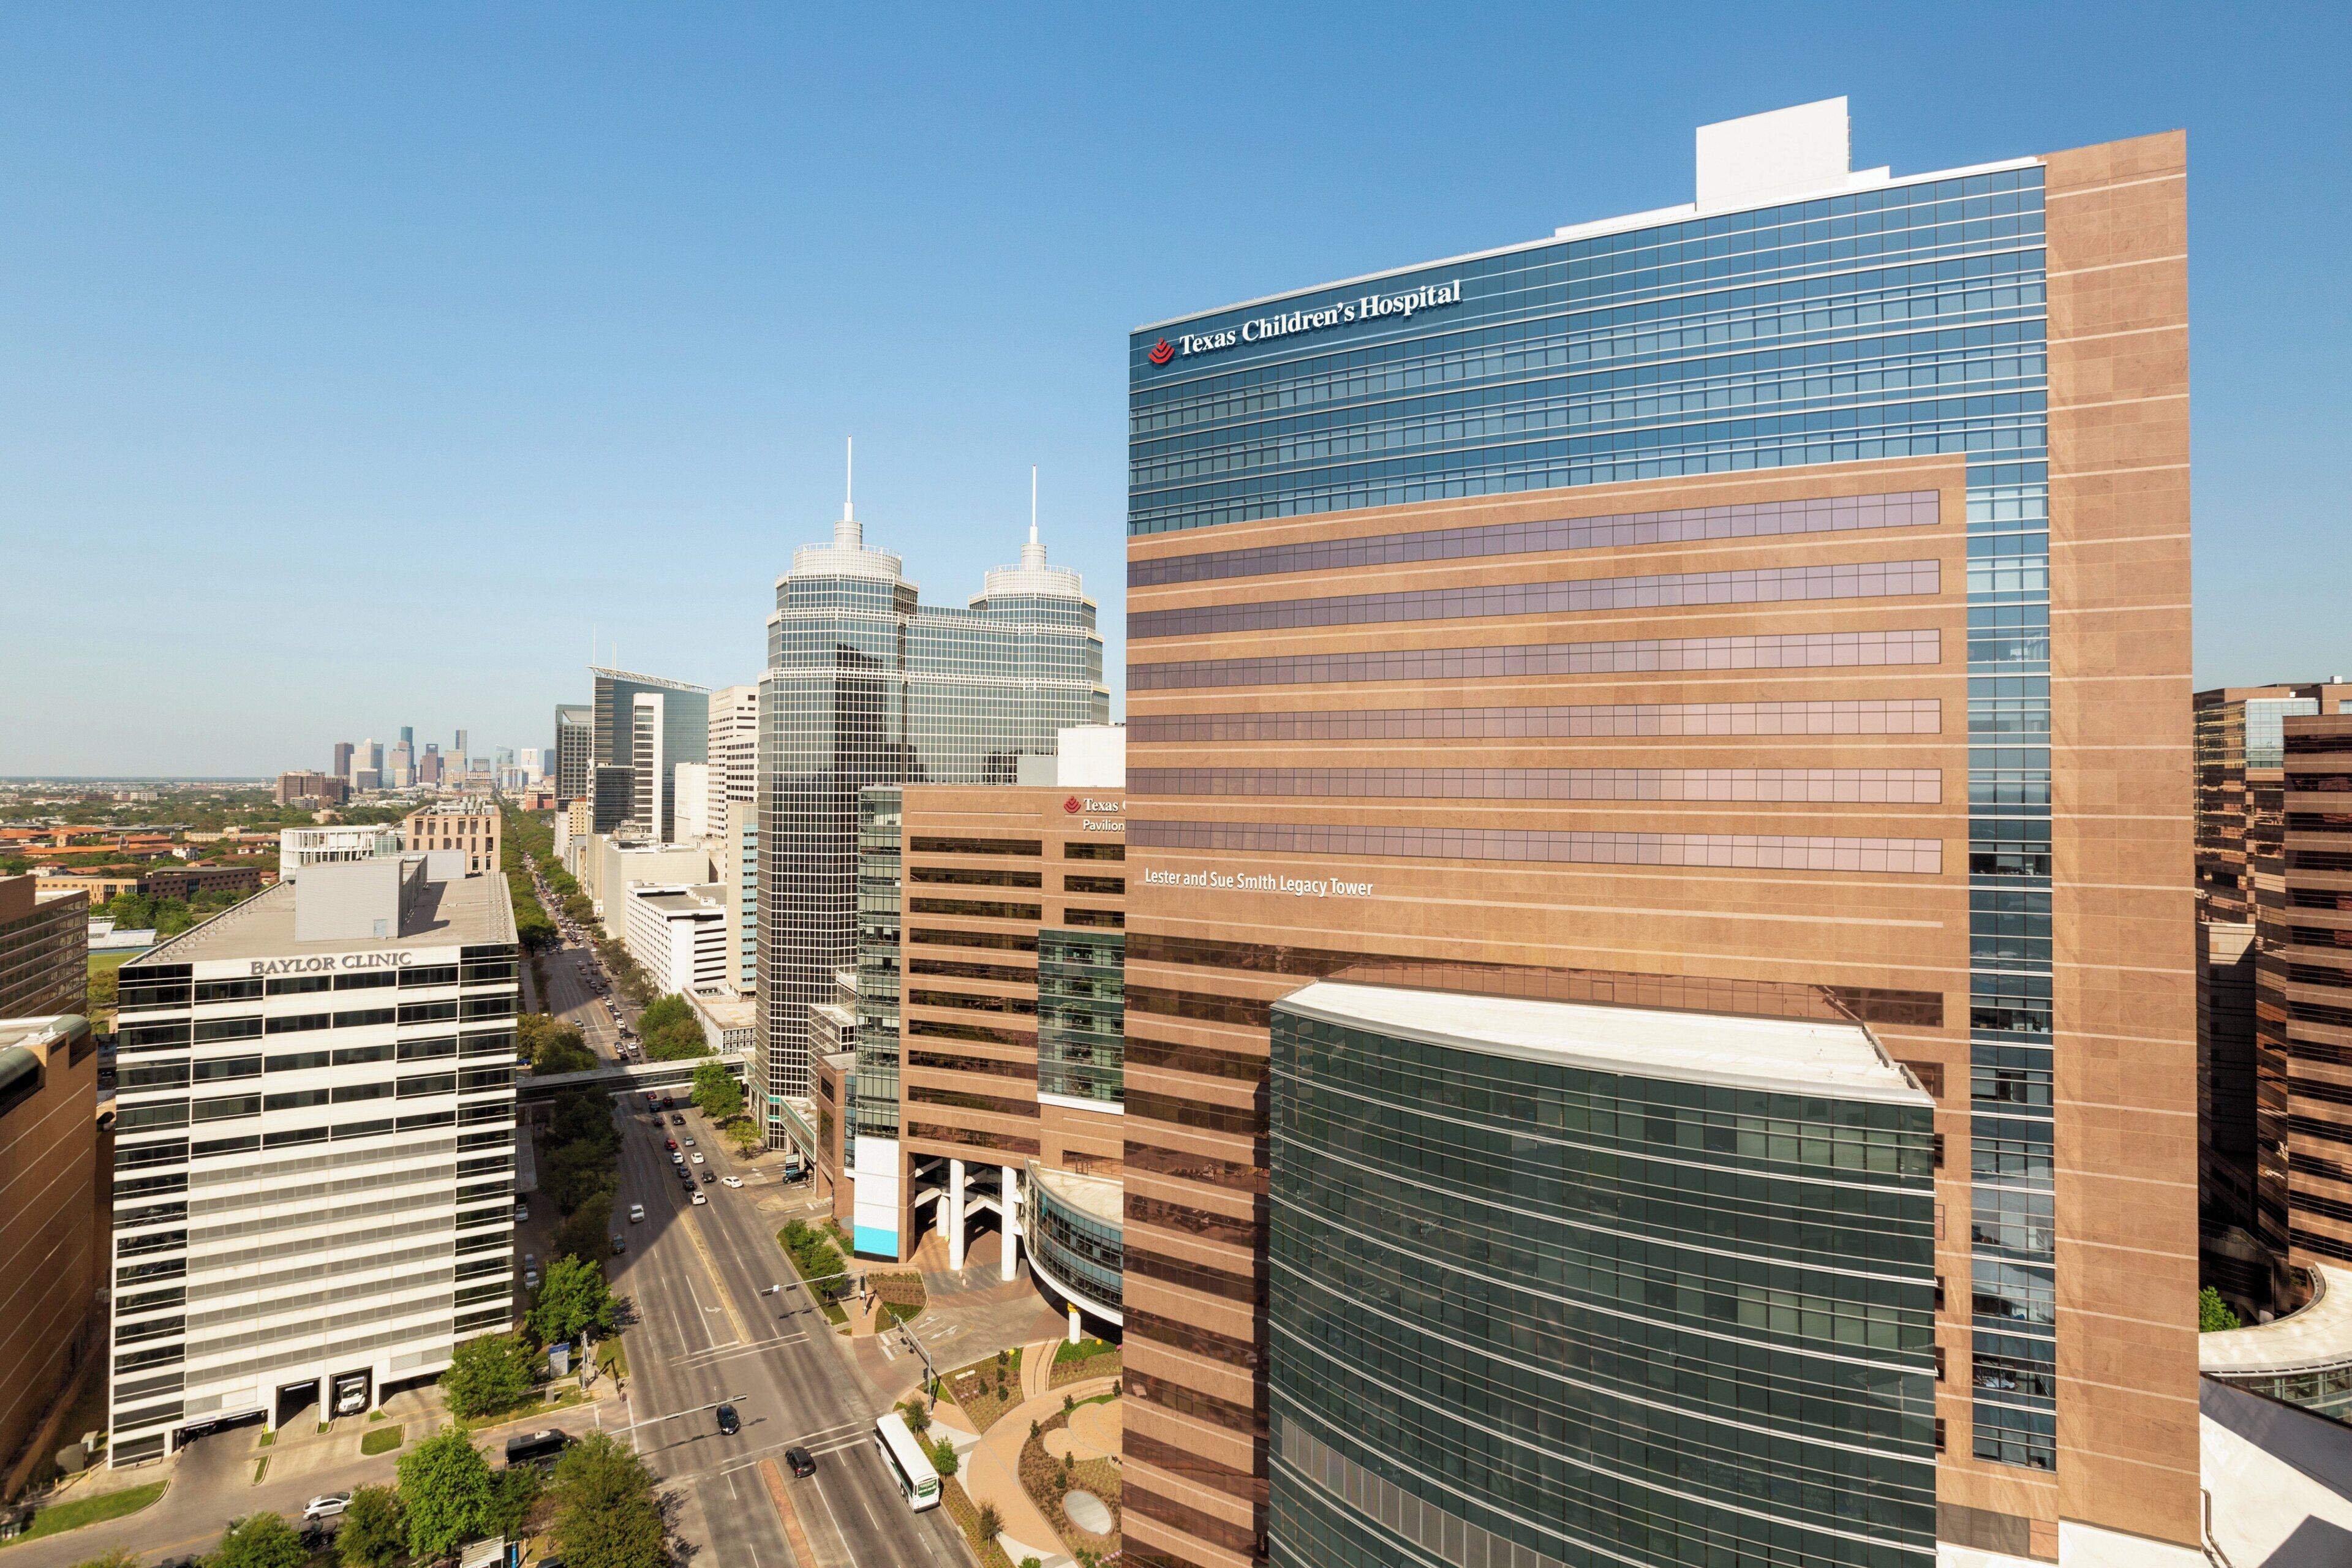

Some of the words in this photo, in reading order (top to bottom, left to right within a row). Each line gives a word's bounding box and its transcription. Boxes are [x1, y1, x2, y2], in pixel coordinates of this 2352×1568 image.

[1180, 330, 1235, 355] Texas
[1359, 279, 1461, 316] Hospital
[1084, 798, 1118, 812] Texas
[1083, 819, 1125, 831] Pavilion
[1145, 868, 1181, 884] Lester
[1184, 870, 1207, 886] and
[1210, 872, 1234, 888] Sue
[1237, 873, 1276, 890] Smith
[1280, 875, 1327, 897] Legacy
[1330, 877, 1373, 896] Tower
[250, 957, 336, 975] BAYLOR
[341, 952, 412, 968] CLINIC
